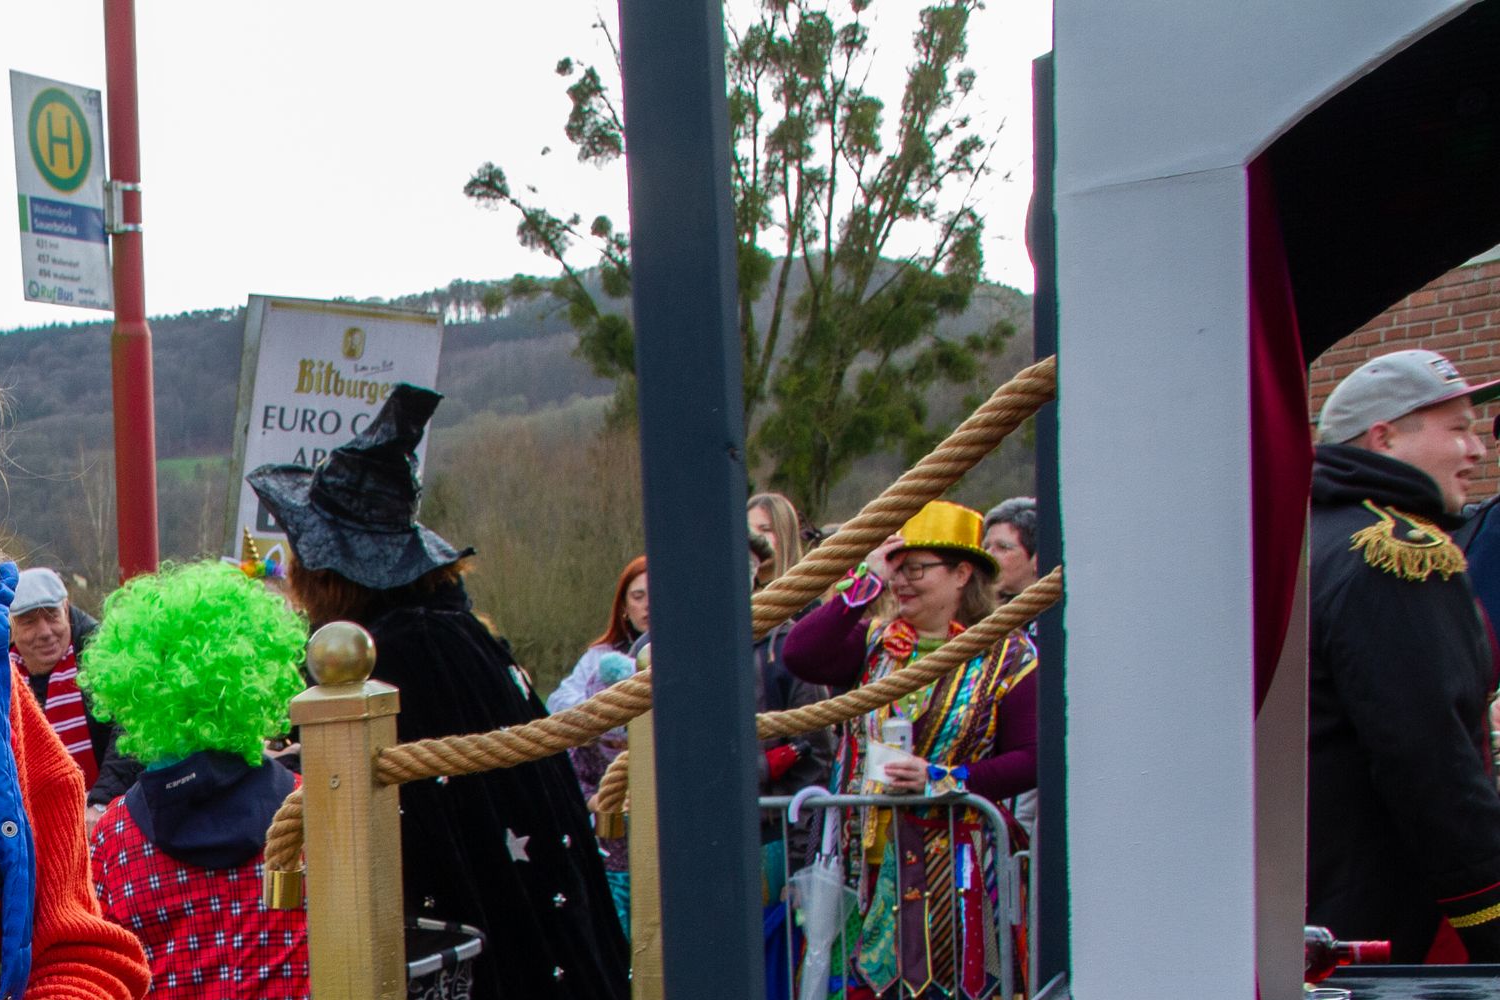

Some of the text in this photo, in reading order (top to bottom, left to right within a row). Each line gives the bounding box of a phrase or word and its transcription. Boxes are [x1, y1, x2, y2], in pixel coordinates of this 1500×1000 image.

[46, 109, 75, 170] H
[295, 358, 396, 405] Bitburge
[262, 405, 372, 435] EURO C
